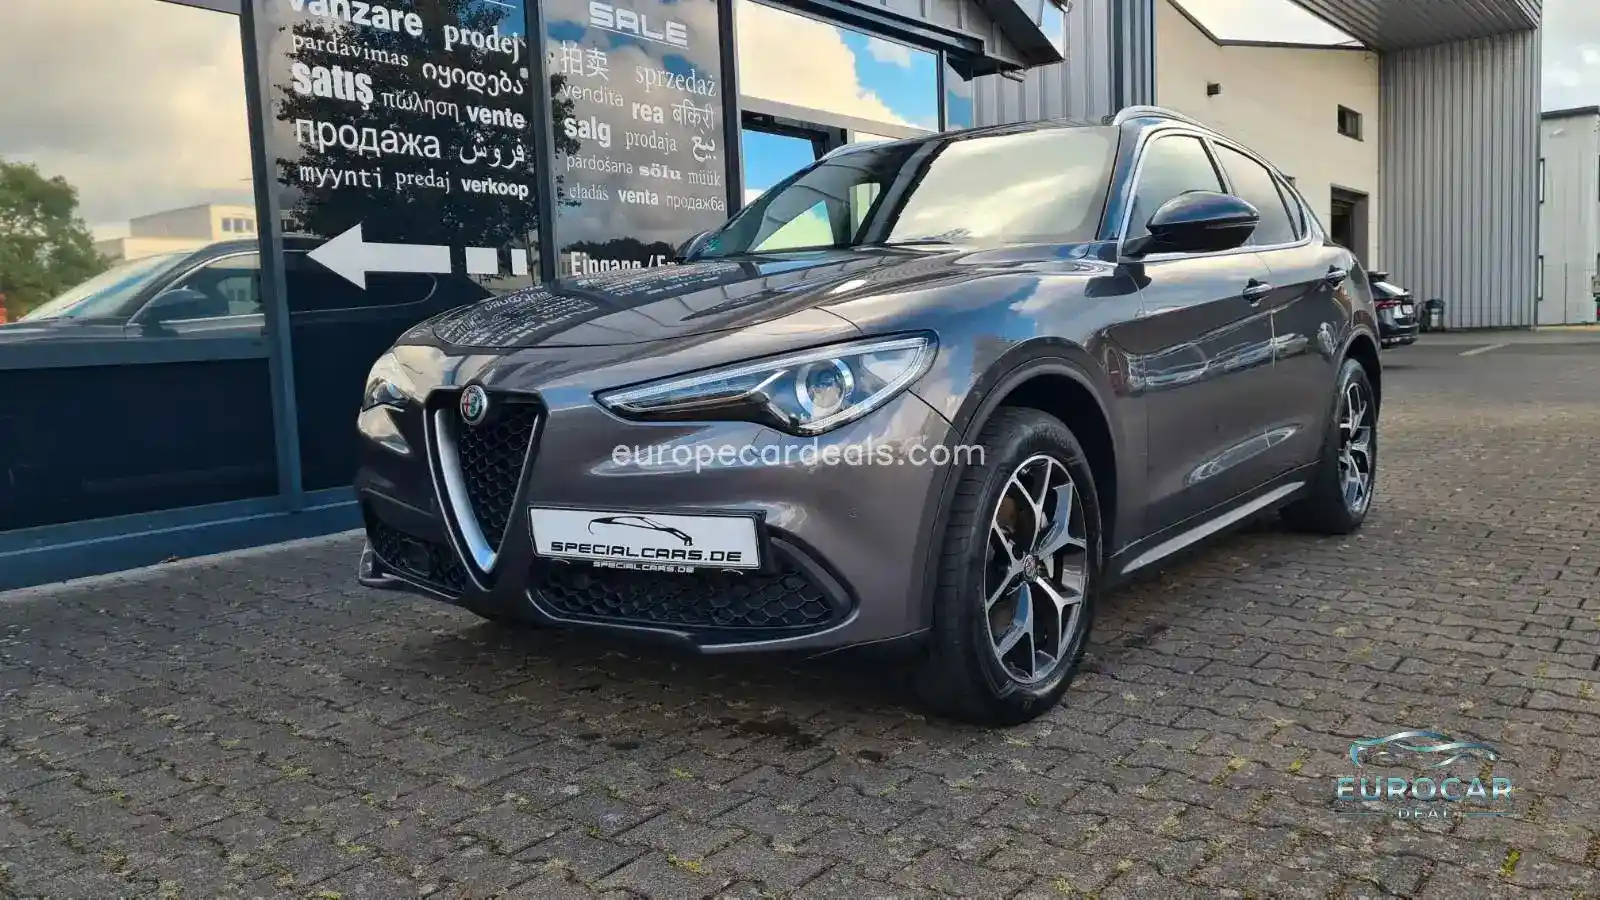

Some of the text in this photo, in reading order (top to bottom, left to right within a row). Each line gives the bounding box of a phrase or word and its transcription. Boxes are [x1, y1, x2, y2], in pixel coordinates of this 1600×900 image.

[589, 1, 688, 46] SALE
[292, 34, 410, 67] pardavimas
[443, 24, 520, 63] prodej
[560, 40, 609, 81] 拍卖
[292, 62, 374, 111] satış
[561, 83, 625, 107] vendita
[635, 65, 717, 97] sprzedaż
[466, 105, 527, 129] vente
[632, 102, 665, 124] rea
[296, 118, 442, 159] продажа
[564, 115, 678, 155] salg prodaja
[299, 164, 530, 201] myynti predaj verkoop
[638, 162, 682, 180] sölu
[687, 170, 722, 187] müük
[617, 188, 659, 206] venta
[666, 192, 725, 212] продажба
[550, 541, 742, 562] SPECIALCARS.DE
[593, 561, 694, 574] SPECIALCARS.DE
